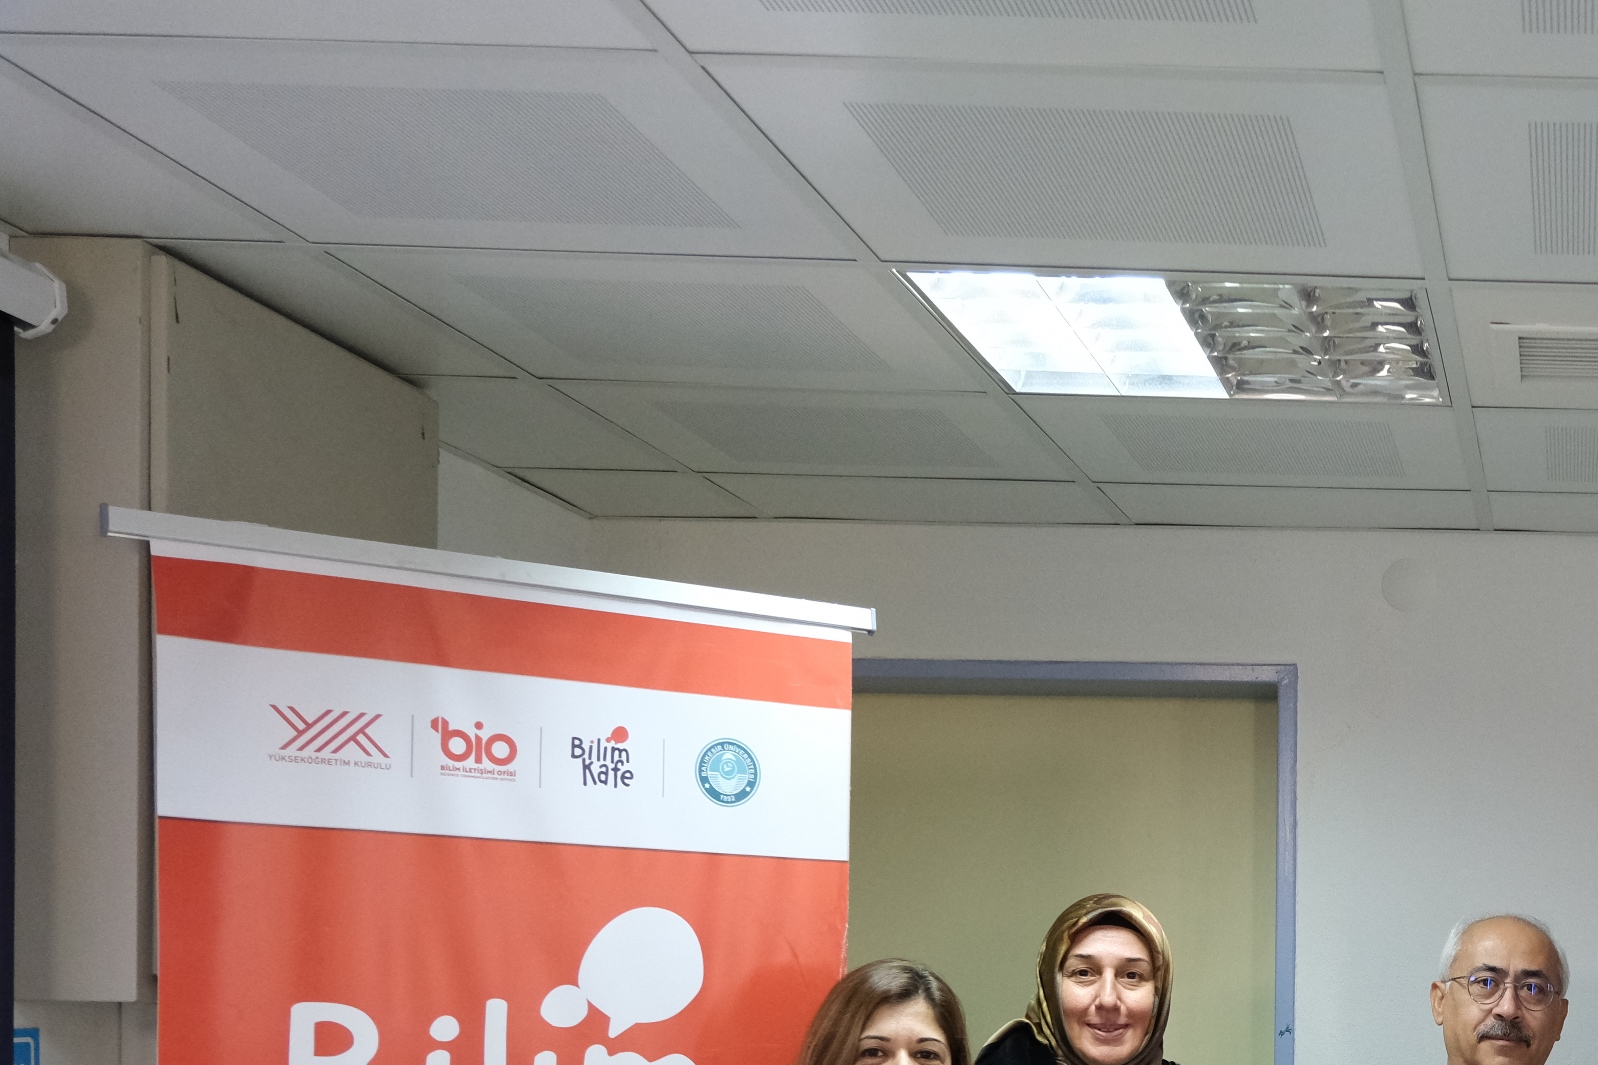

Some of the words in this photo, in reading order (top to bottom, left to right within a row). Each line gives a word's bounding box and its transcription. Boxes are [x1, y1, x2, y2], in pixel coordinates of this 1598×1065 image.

[430, 716, 518, 767] bio
[570, 735, 630, 764] Bilim
[267, 753, 351, 767] YÜKSEKÖĞRETİM
[353, 760, 392, 770] KURULU
[581, 757, 634, 788] Kafe
